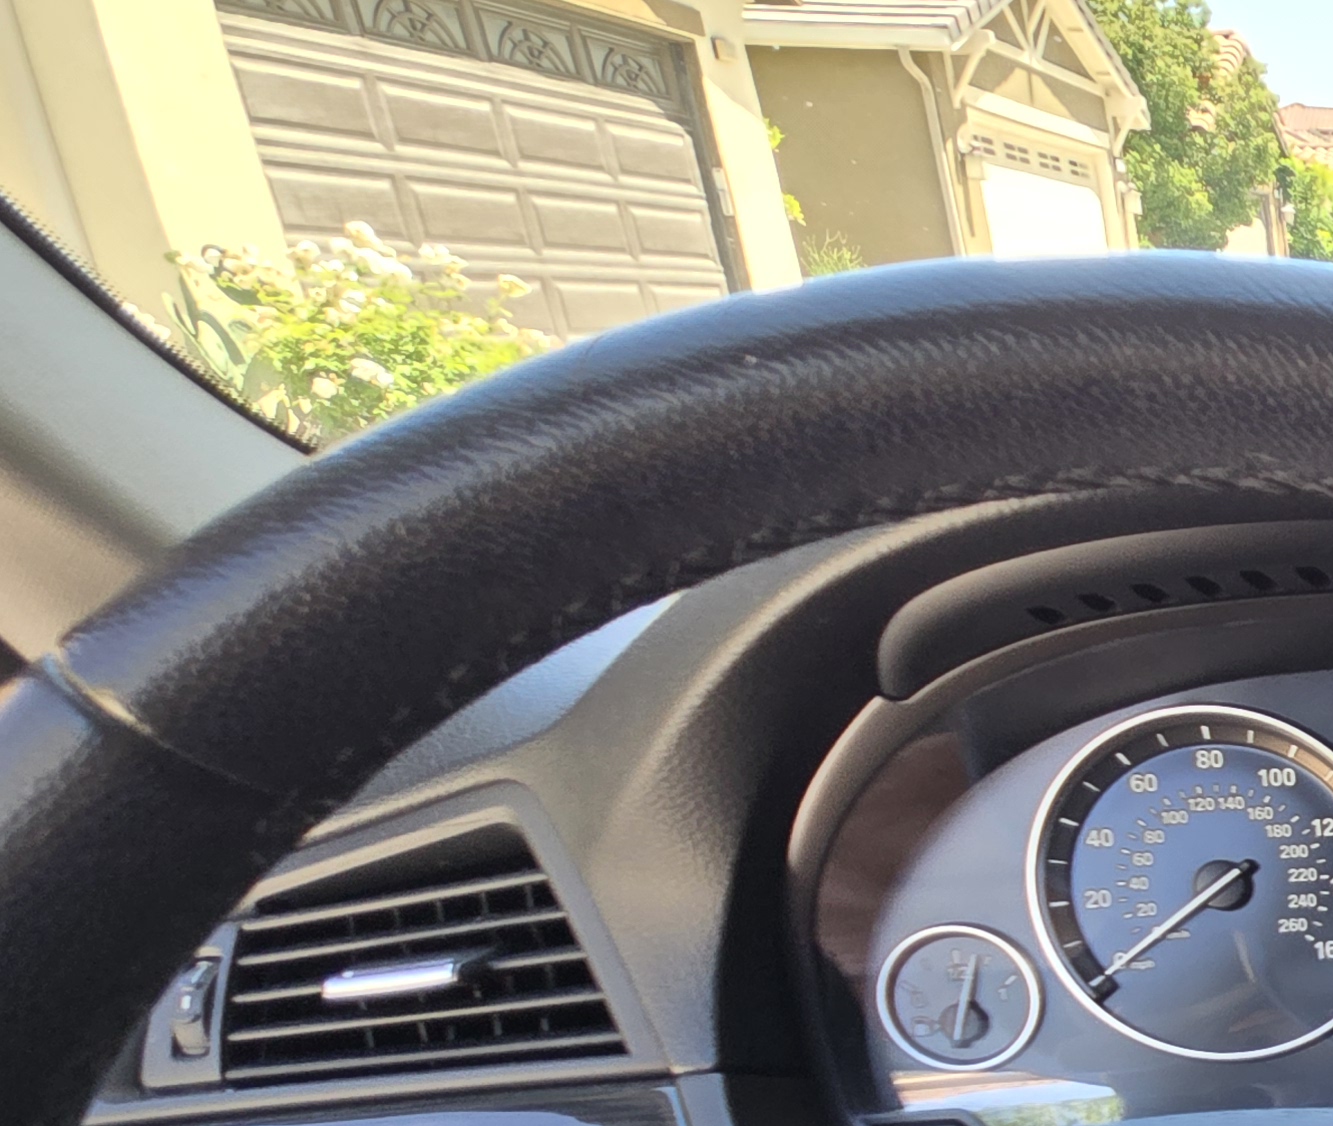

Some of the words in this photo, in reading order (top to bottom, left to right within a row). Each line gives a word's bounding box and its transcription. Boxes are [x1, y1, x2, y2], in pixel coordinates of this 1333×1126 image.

[1195, 750, 1223, 768] 80
[1129, 774, 1158, 792] 60
[1258, 768, 1296, 786] 100
[1188, 797, 1215, 811] 120
[1218, 796, 1245, 810] 140
[1161, 810, 1189, 824] 100
[1247, 807, 1273, 820] 160
[1085, 829, 1114, 847] 40
[1144, 830, 1165, 844] 80
[1265, 824, 1292, 838] 180
[1279, 844, 1308, 858] 200
[1132, 852, 1154, 866] 60
[1288, 868, 1317, 882] 220
[1129, 877, 1149, 890] 40
[1083, 889, 1112, 909] 20
[1288, 893, 1317, 908] 240
[1136, 903, 1157, 916] 20
[1278, 918, 1307, 933] 260
